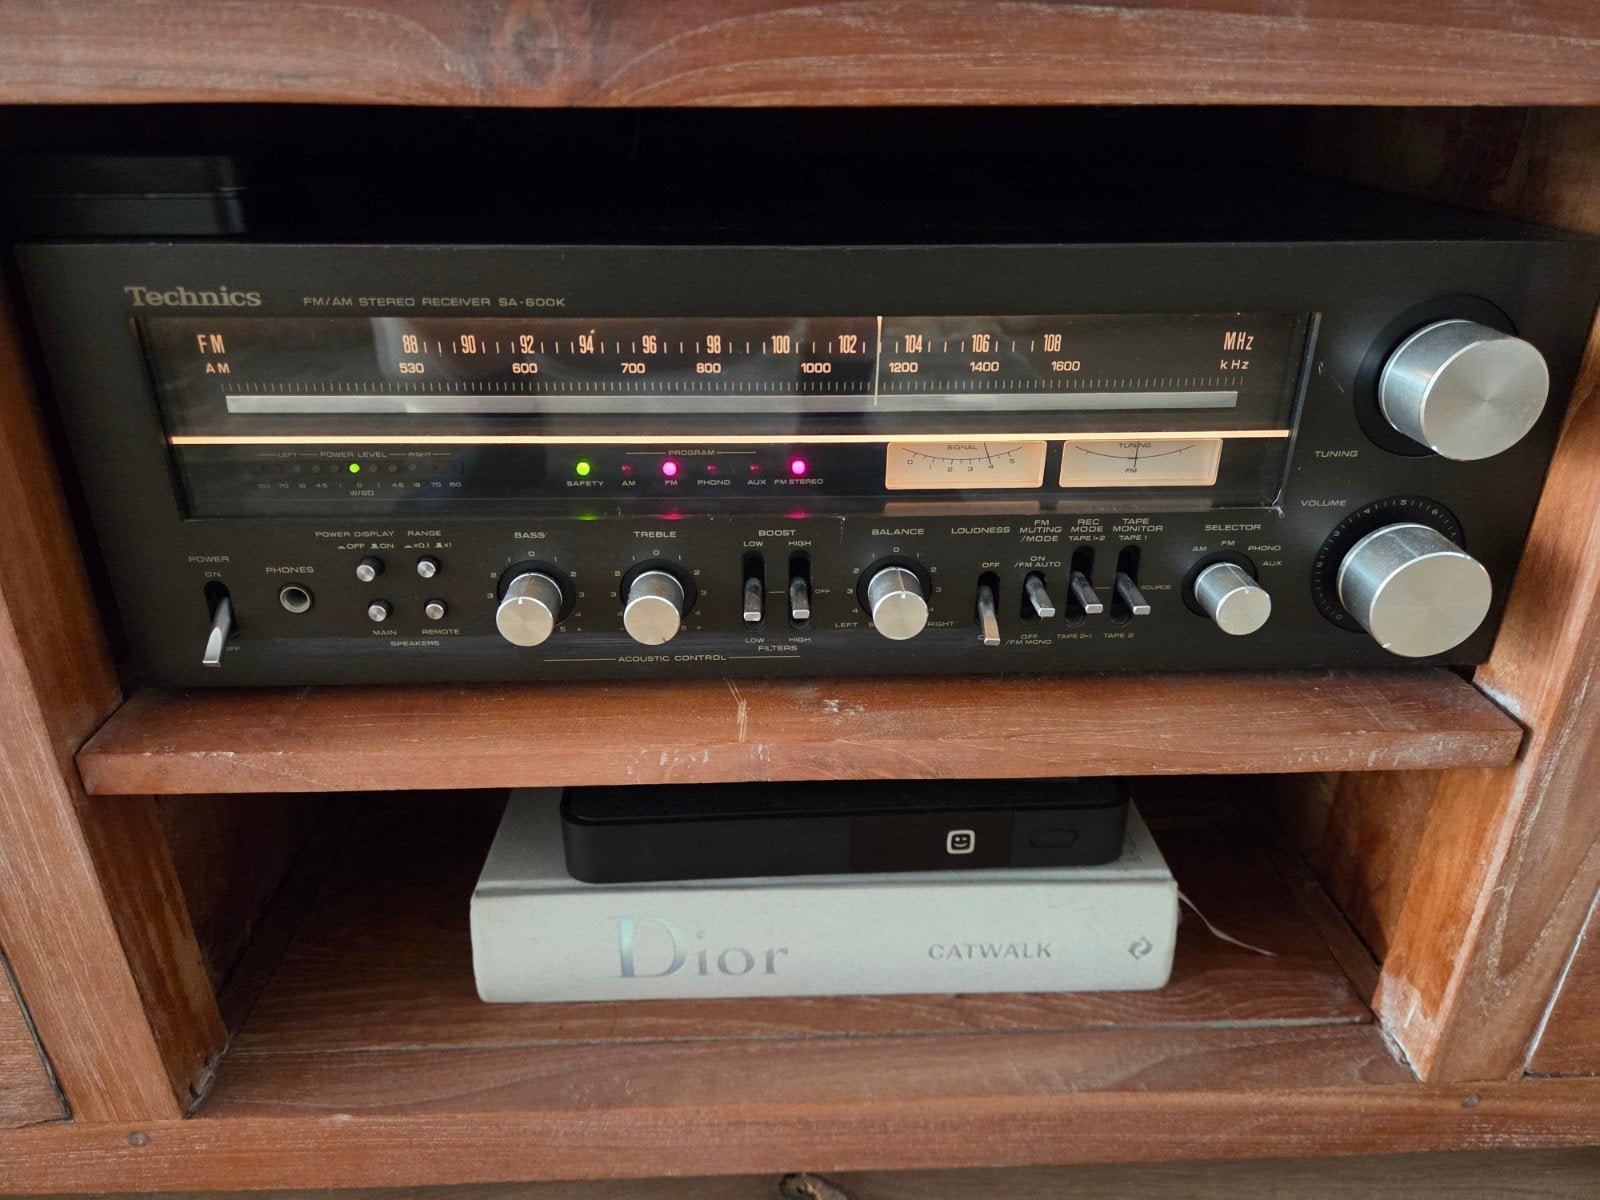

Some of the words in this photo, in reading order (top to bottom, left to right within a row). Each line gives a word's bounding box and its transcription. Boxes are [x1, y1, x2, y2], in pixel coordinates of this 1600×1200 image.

[124, 286, 263, 308] Technics
[303, 297, 353, 307] FM/AM
[359, 297, 416, 307] STEREO
[422, 297, 491, 307] RECEIVER
[498, 297, 566, 307] SA-600K
[196, 334, 226, 355] FM
[402, 334, 419, 354] 88
[461, 334, 477, 354] 90
[520, 334, 535, 354] 92
[579, 334, 594, 354] 94
[642, 334, 657, 354] 96
[706, 334, 722, 354] 98
[772, 334, 791, 354] 100
[838, 334, 858, 354] 102
[904, 334, 923, 354] 104
[972, 334, 991, 353] 106
[1044, 333, 1062, 352] 108
[1223, 331, 1255, 351] MHz
[205, 362, 230, 374] AM
[399, 362, 425, 374] 530
[512, 362, 538, 374] 600
[621, 362, 646, 374] 700
[696, 362, 722, 374] 800
[800, 362, 832, 374] 1000
[888, 362, 919, 374] 1200
[970, 361, 1000, 372] 1400
[1050, 360, 1081, 372] 1600
[1219, 358, 1250, 370] kHz
[1314, 450, 1360, 458] TUNING
[774, 478, 788, 486] FM
[788, 478, 824, 486] STEREO
[1301, 499, 1347, 507] VOLUME
[1077, 518, 1100, 526] REC
[315, 530, 350, 538] POWER
[354, 530, 394, 538] DISPLAY
[633, 530, 677, 538] TREBLE
[758, 529, 796, 537] BOOST
[872, 528, 925, 536] BALANCE
[1019, 526, 1062, 534] MUTING
[1020, 534, 1059, 542] /MODE
[346, 542, 365, 550] OFF
[188, 556, 230, 564] POWER
[1032, 560, 1061, 568] AUTO
[204, 570, 222, 578] ON
[266, 566, 315, 574] PHONES
[486, 592, 494, 600] 3
[788, 636, 812, 644] HIGH
[1024, 638, 1052, 646] MONO
[674, 654, 728, 662] CONTROL
[602, 913, 790, 980] Dior
[927, 942, 1054, 961] CATWALK
